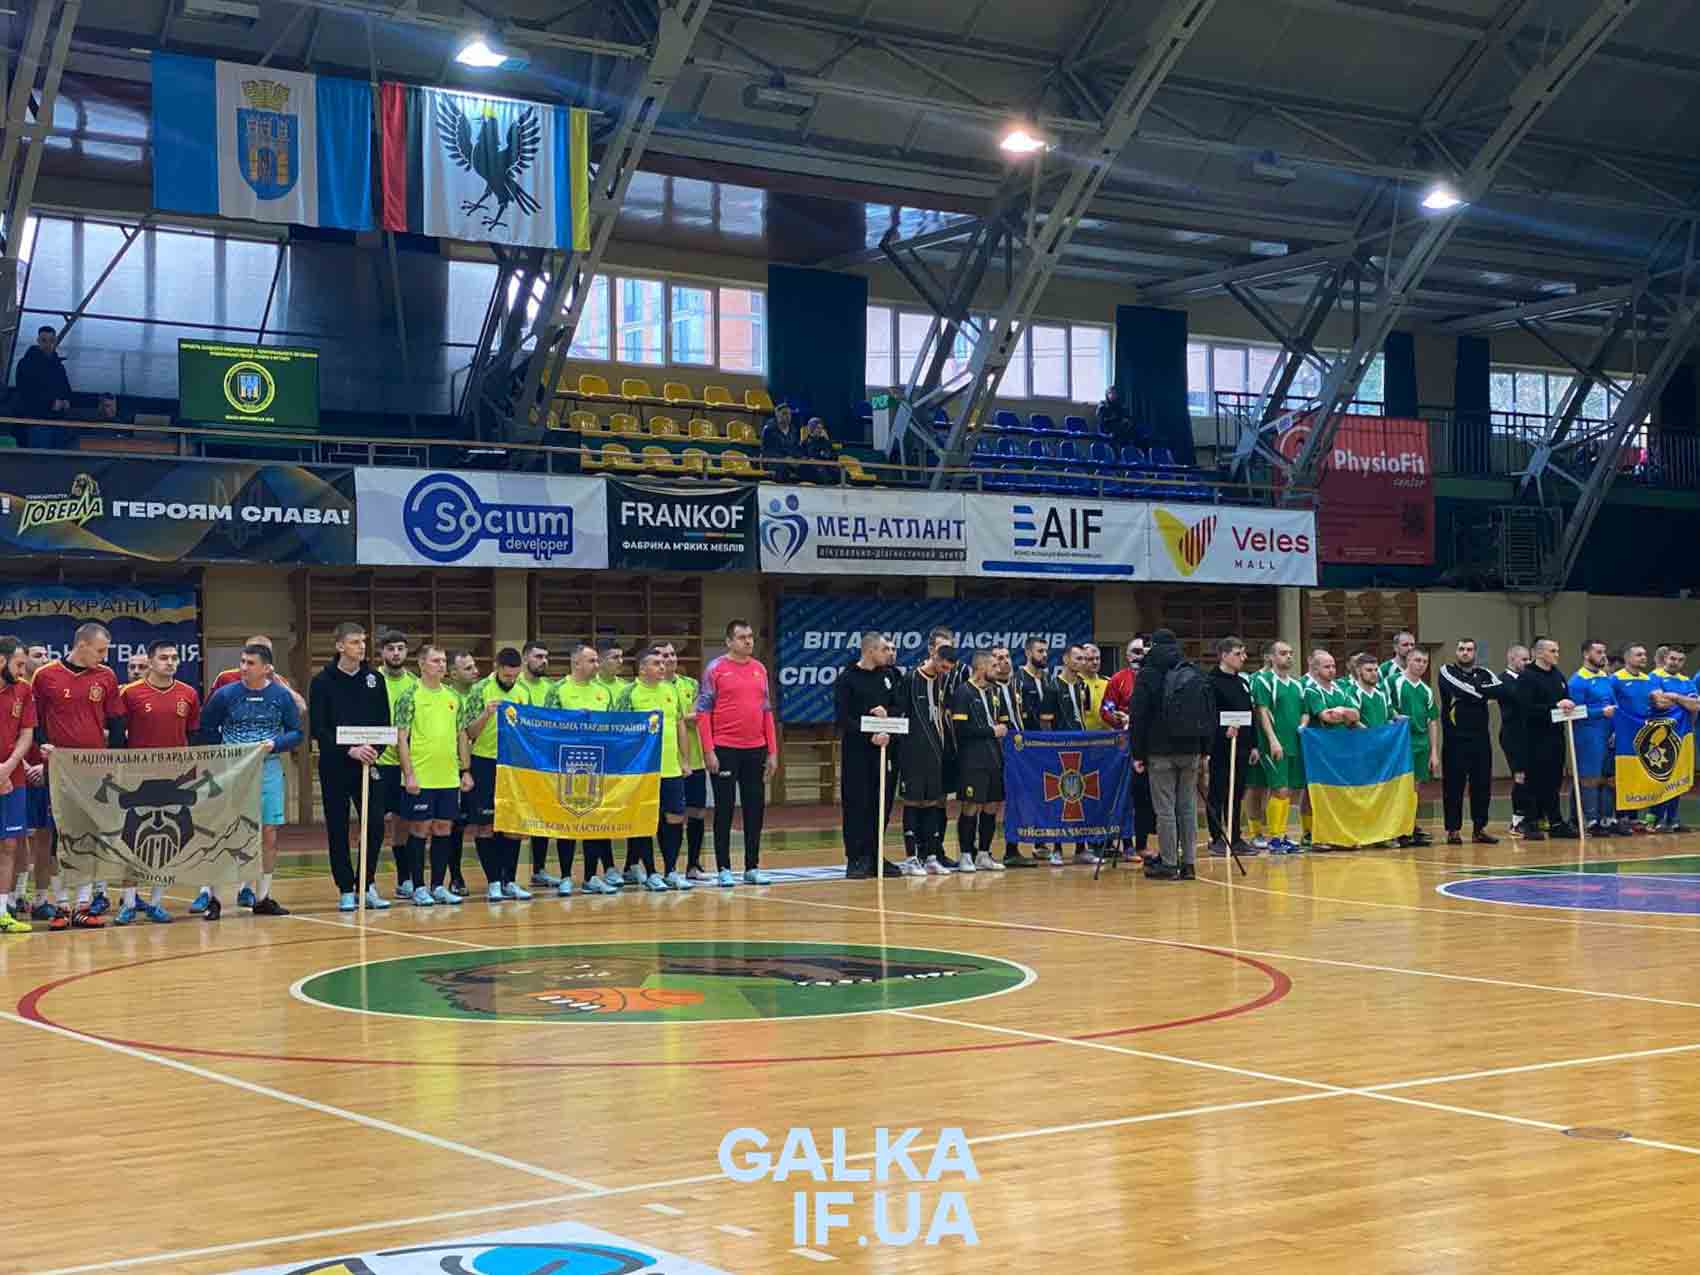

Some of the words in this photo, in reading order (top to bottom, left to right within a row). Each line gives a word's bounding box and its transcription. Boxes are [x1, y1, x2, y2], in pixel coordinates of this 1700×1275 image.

[1334, 448, 1425, 478] PhysioFit
[112, 500, 233, 521] ГЕРОЯМ
[240, 504, 350, 525] СЛАВА!
[435, 501, 570, 535] Socium
[621, 501, 745, 529] FRANKOF
[816, 515, 966, 543] МЕД-АТЛАНТ
[1231, 525, 1310, 555] Veles
[505, 537, 569, 560] developer
[622, 540, 670, 550] ФАБРИКА
[1234, 558, 1276, 571] MALL
[49, 598, 159, 614] УКРАЇНИ
[63, 688, 72, 698] 2
[144, 703, 153, 713] 5
